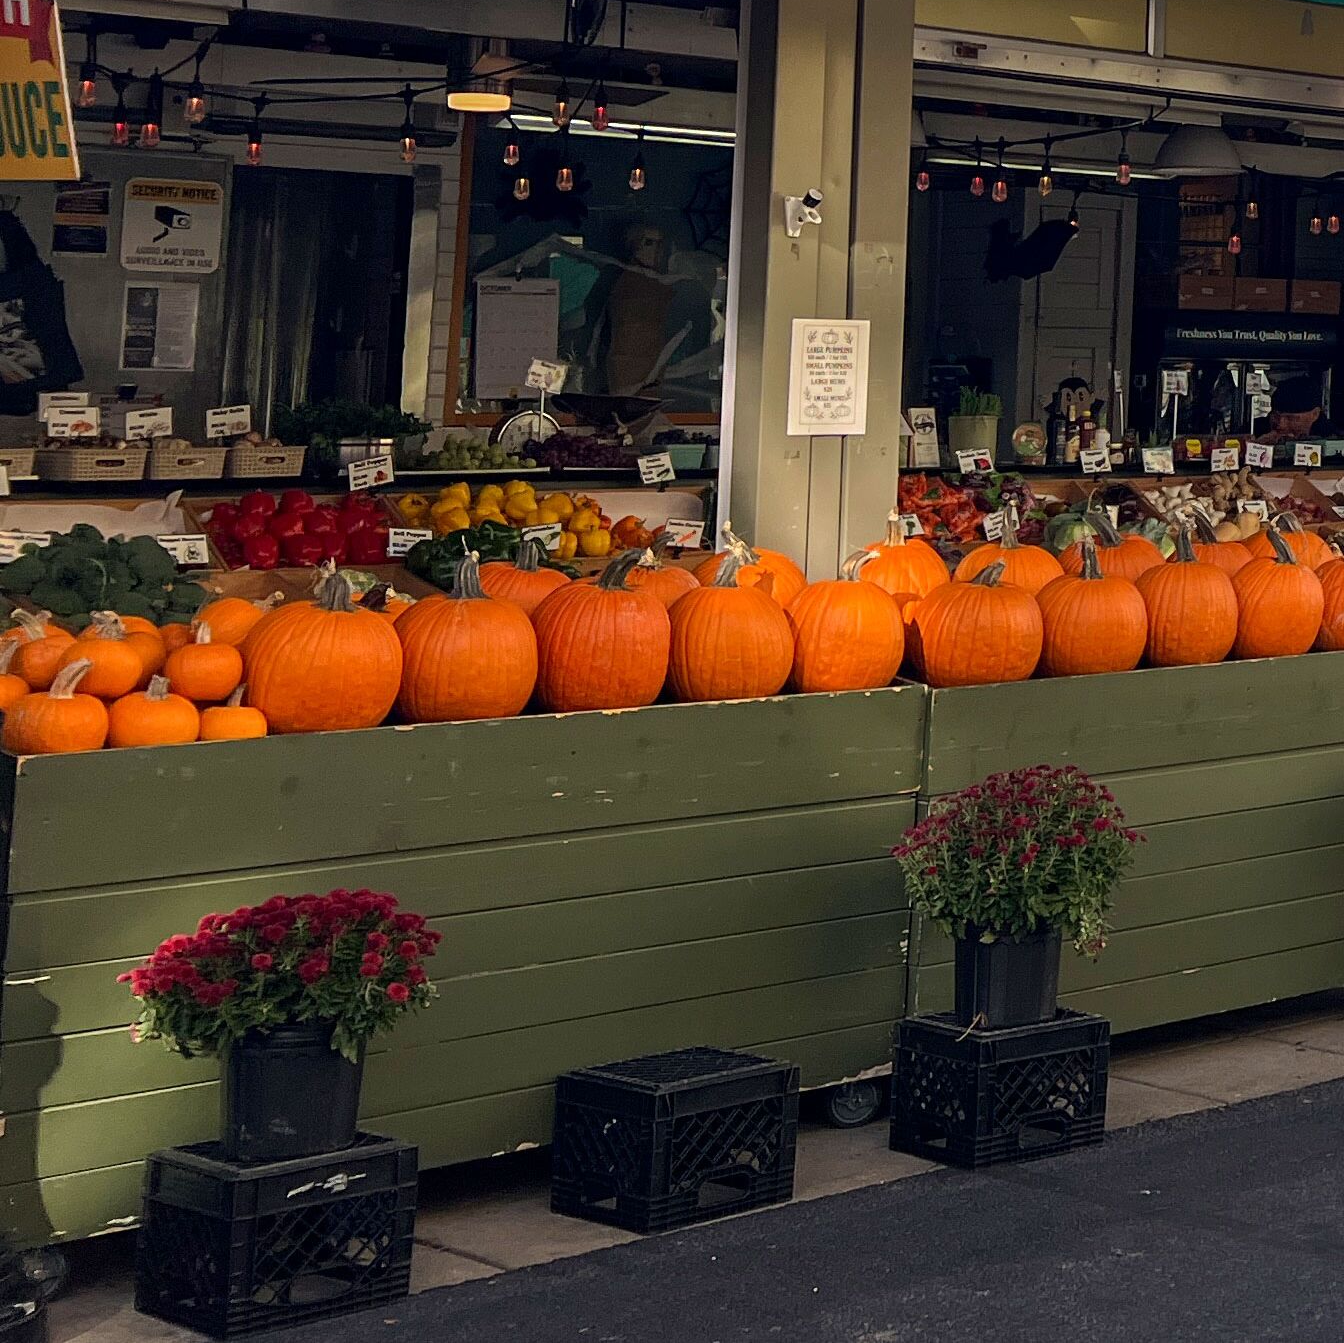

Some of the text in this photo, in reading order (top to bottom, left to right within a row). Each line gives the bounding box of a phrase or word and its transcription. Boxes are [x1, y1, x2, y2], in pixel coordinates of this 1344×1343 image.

[0, 80, 70, 159] UCE
[1176, 328, 1217, 339] Freshness
[1217, 329, 1233, 340] You
[1234, 329, 1258, 340] Trust,
[1259, 330, 1287, 342] Quality
[1287, 331, 1302, 341] You
